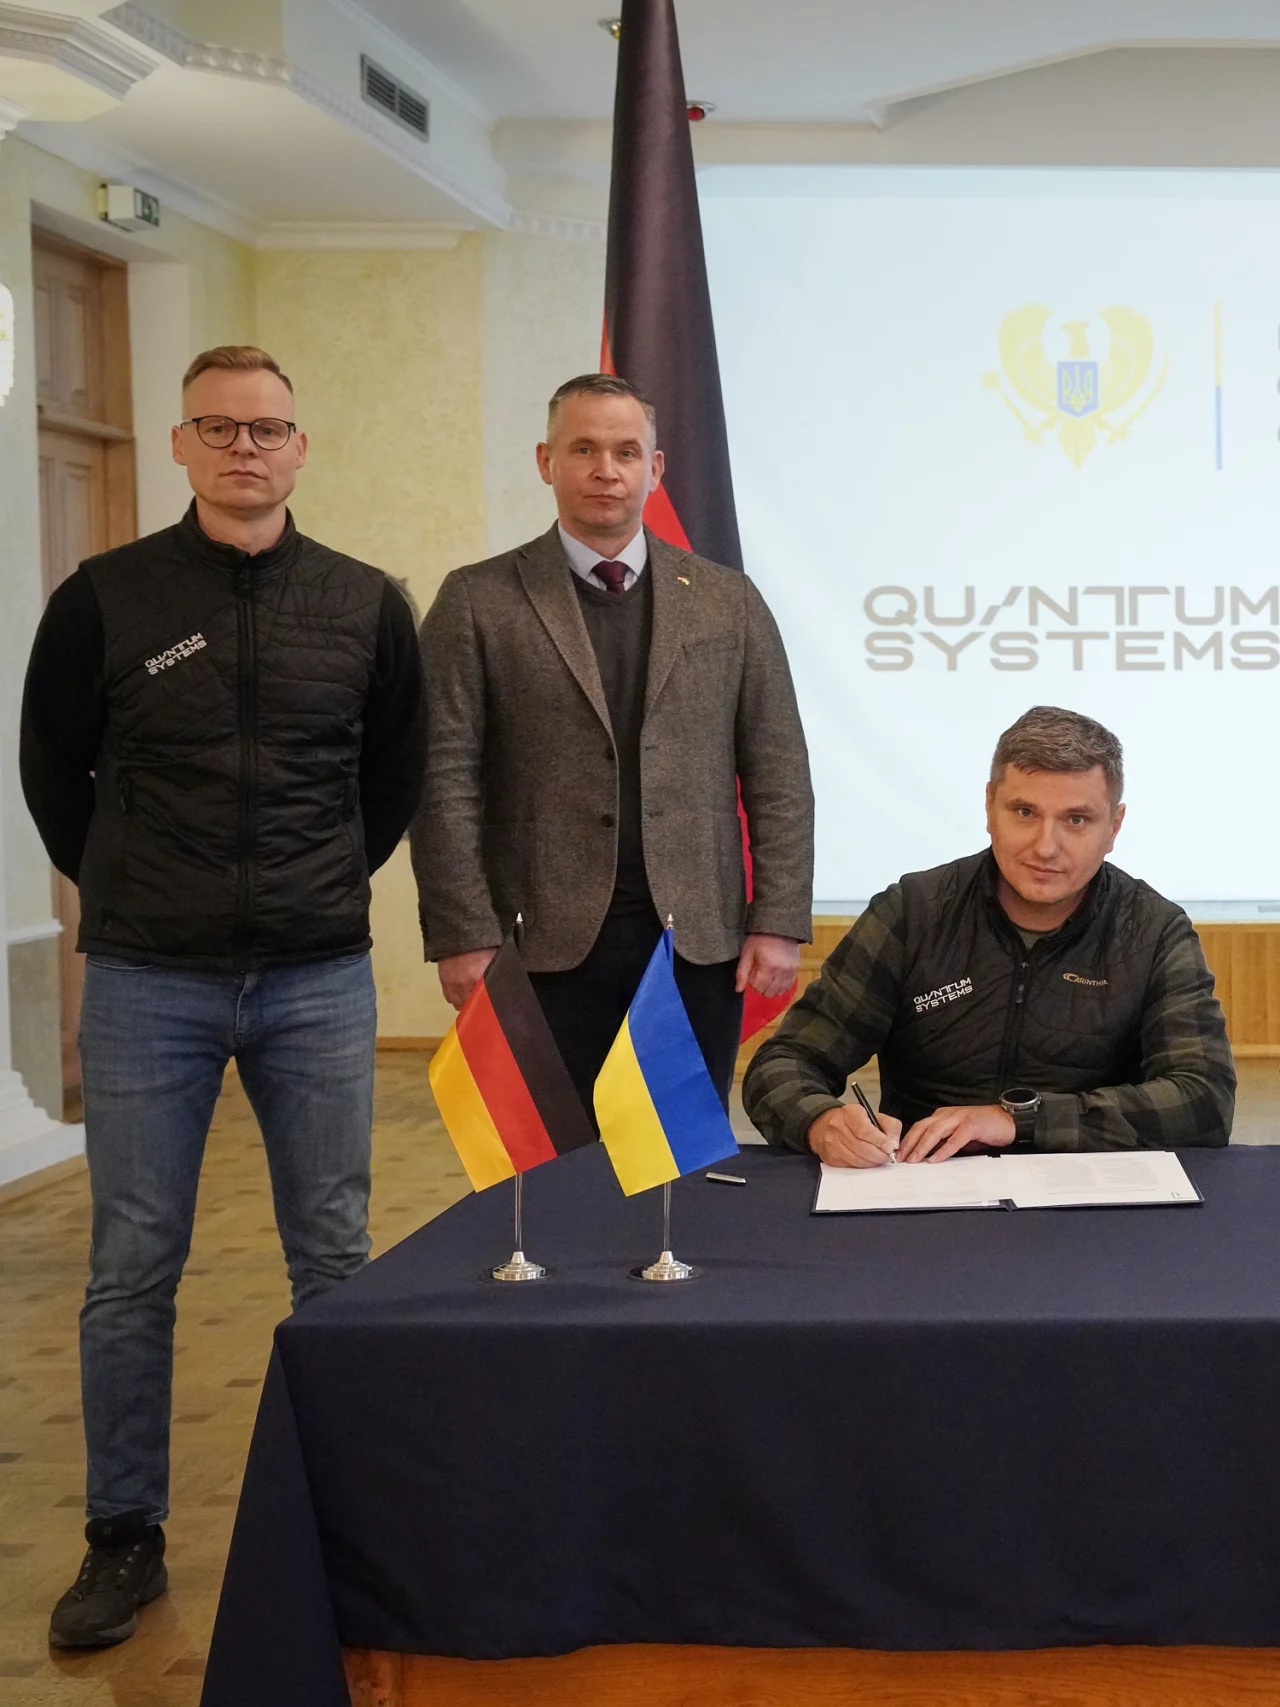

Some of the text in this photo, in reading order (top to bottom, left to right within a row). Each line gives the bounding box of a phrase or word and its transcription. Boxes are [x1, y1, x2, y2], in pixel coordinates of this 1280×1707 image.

[148, 640, 207, 675] SYSTEMS
[863, 631, 1280, 672] SYSTEMS
[915, 985, 973, 1013] SYSTEMS
